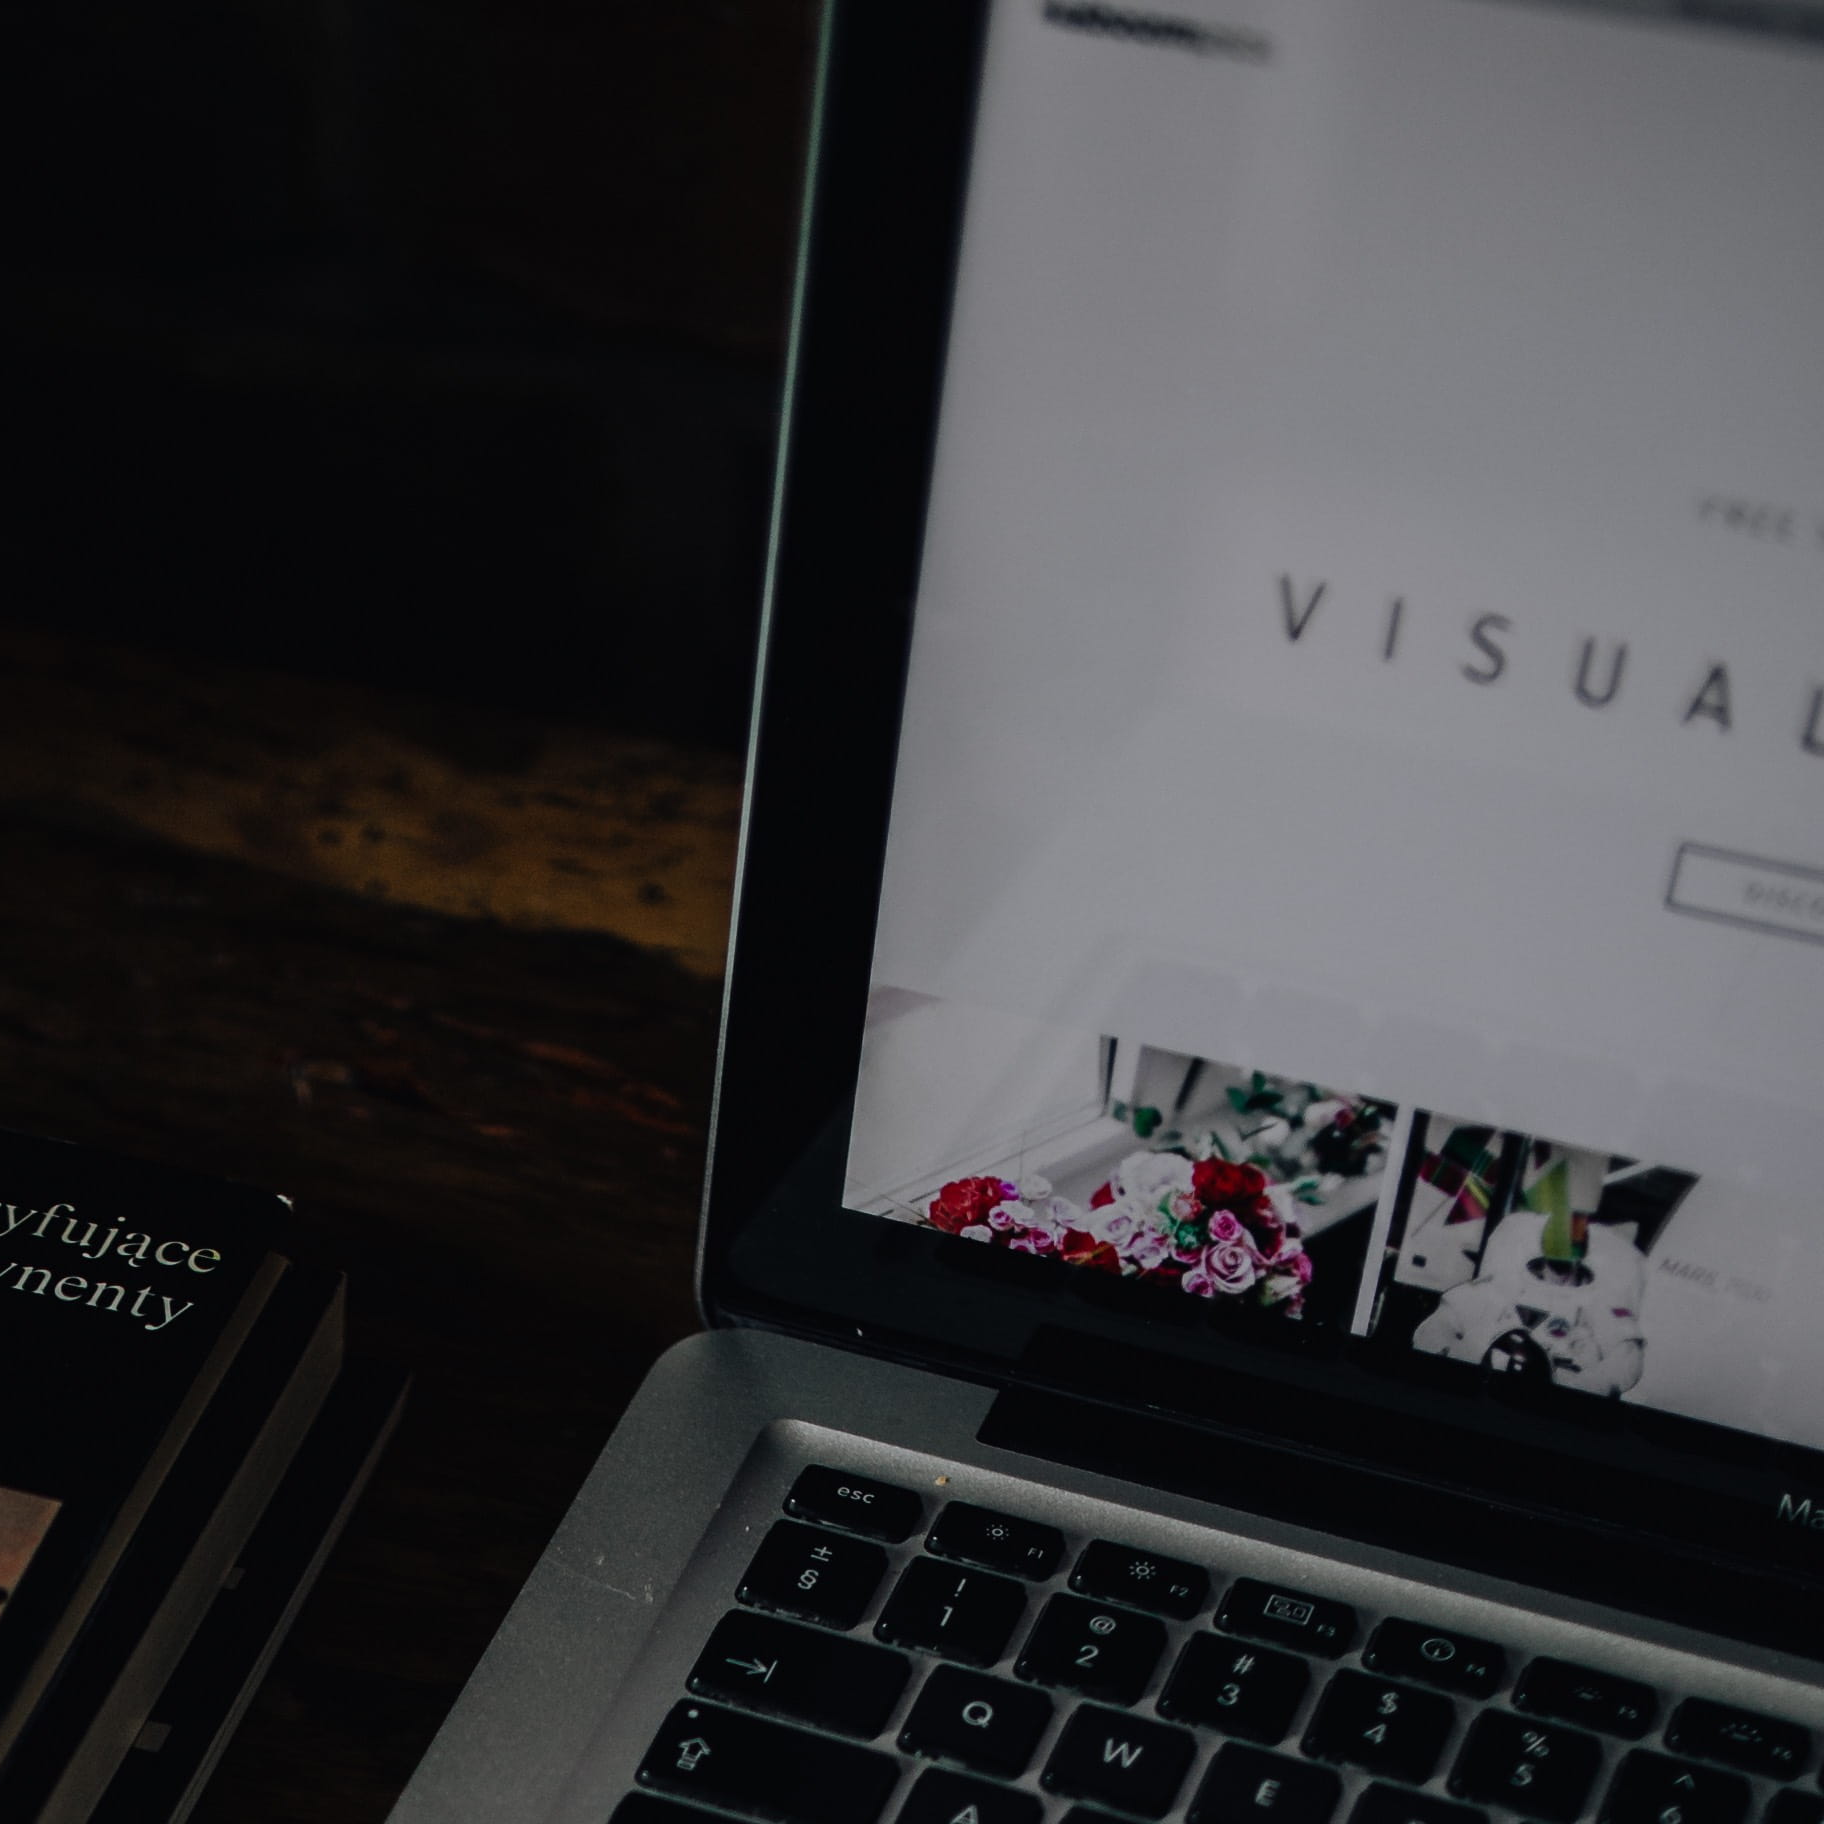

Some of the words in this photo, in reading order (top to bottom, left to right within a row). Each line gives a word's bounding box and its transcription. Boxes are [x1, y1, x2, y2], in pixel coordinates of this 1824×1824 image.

[837, 1486, 875, 1504] esc
[1776, 1494, 1824, 1529] Ma
[1027, 1547, 1044, 1559] F1
[1169, 1584, 1188, 1596] F2
[1089, 1615, 1117, 1634] @
[1075, 1645, 1099, 1665] 2
[1233, 1654, 1255, 1674] #
[1217, 1683, 1240, 1705] 3
[962, 1701, 993, 1728] Q
[1364, 1723, 1387, 1744] 4
[1523, 1731, 1548, 1756] %
[1103, 1738, 1143, 1768] W
[1255, 1779, 1278, 1806] E
